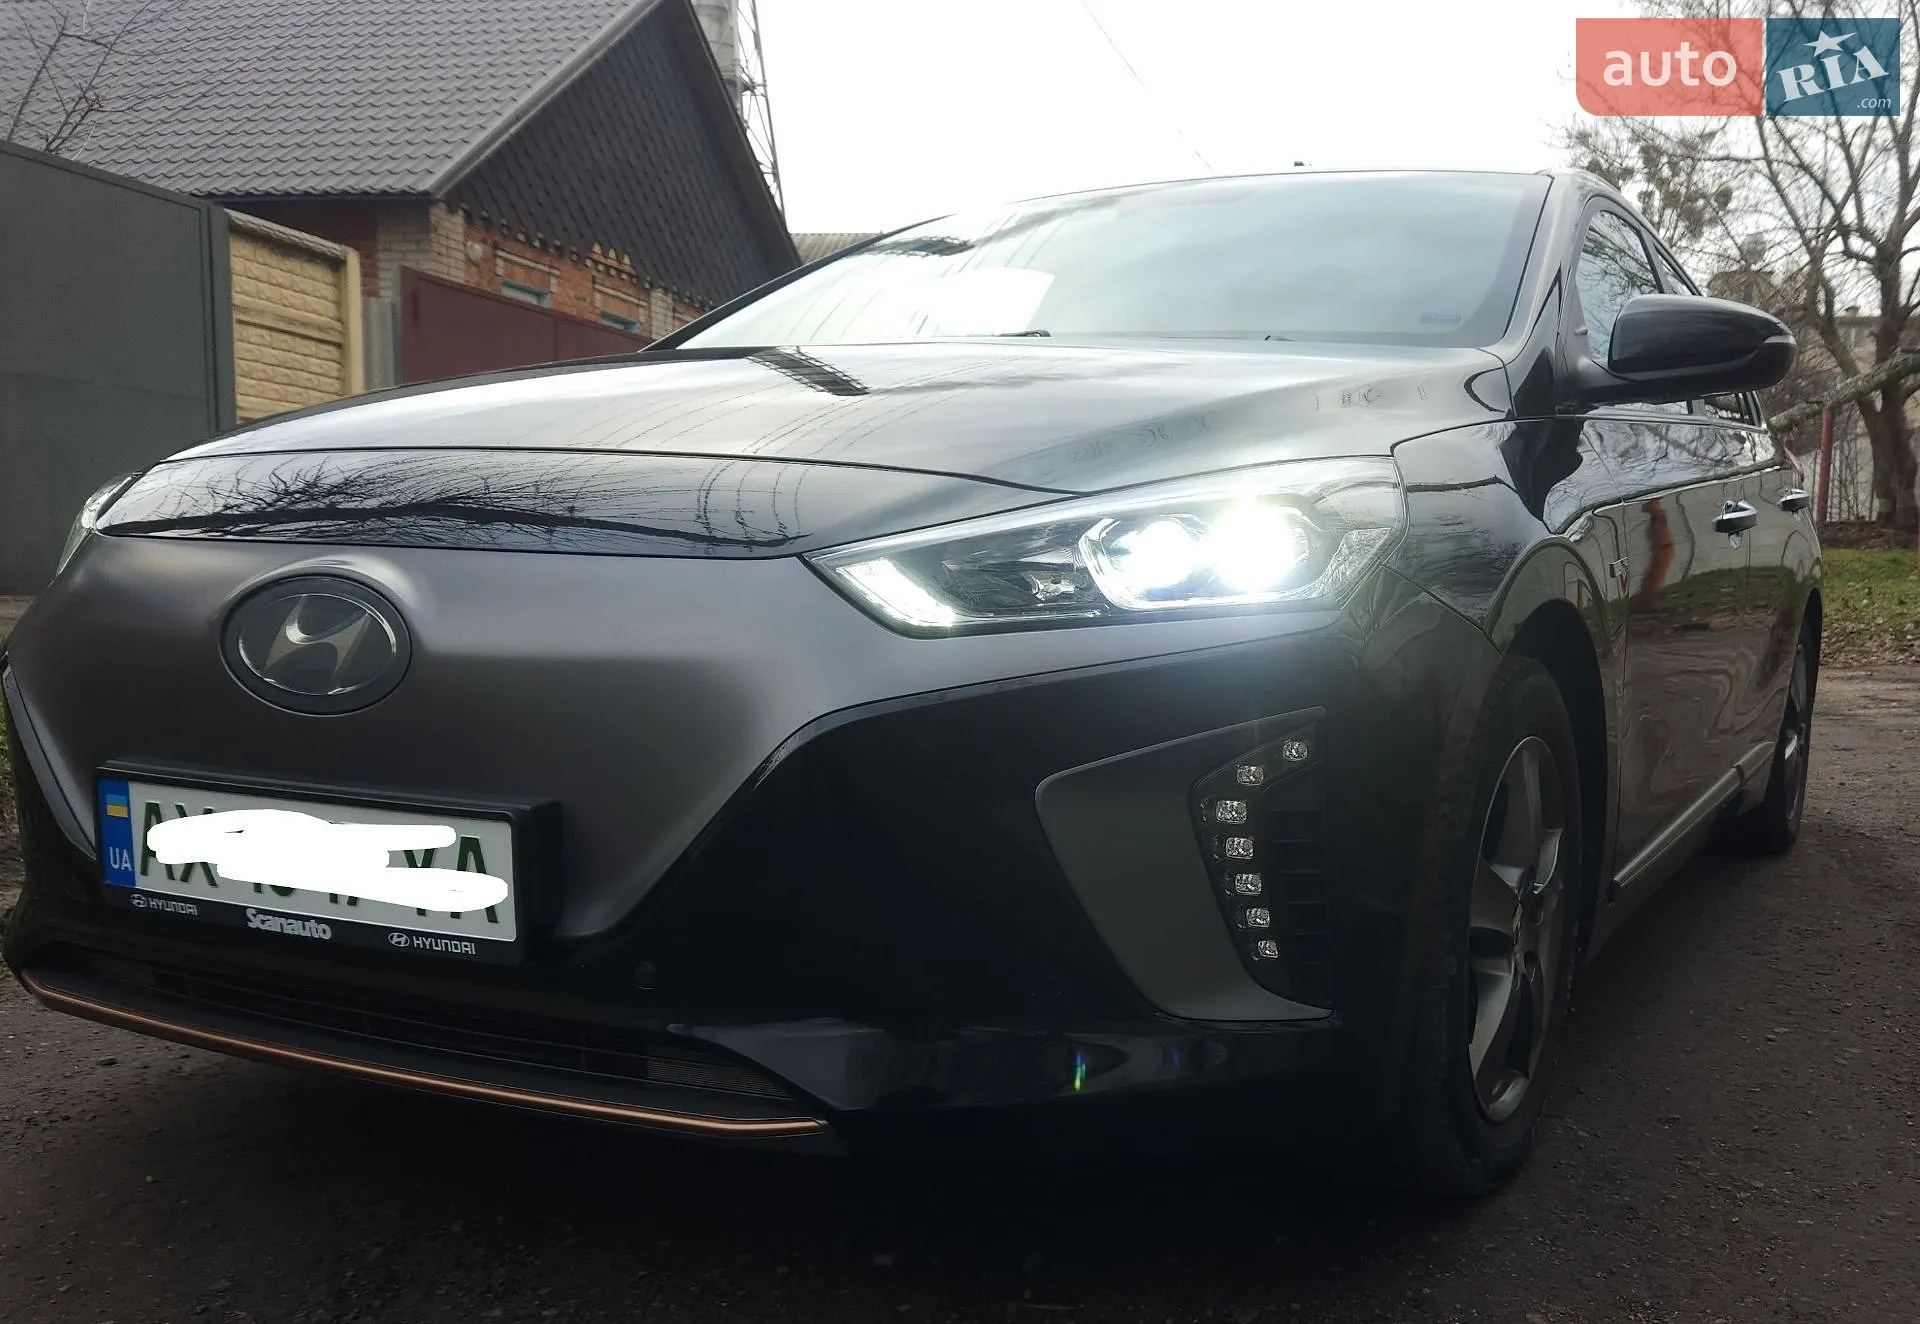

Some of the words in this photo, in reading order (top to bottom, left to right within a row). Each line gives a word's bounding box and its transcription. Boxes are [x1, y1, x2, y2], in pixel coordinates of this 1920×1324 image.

[109, 846, 133, 872] UA
[148, 897, 198, 916] HYUNDAI
[245, 907, 332, 940] Scanauto
[412, 935, 476, 955] HYUNDAI
